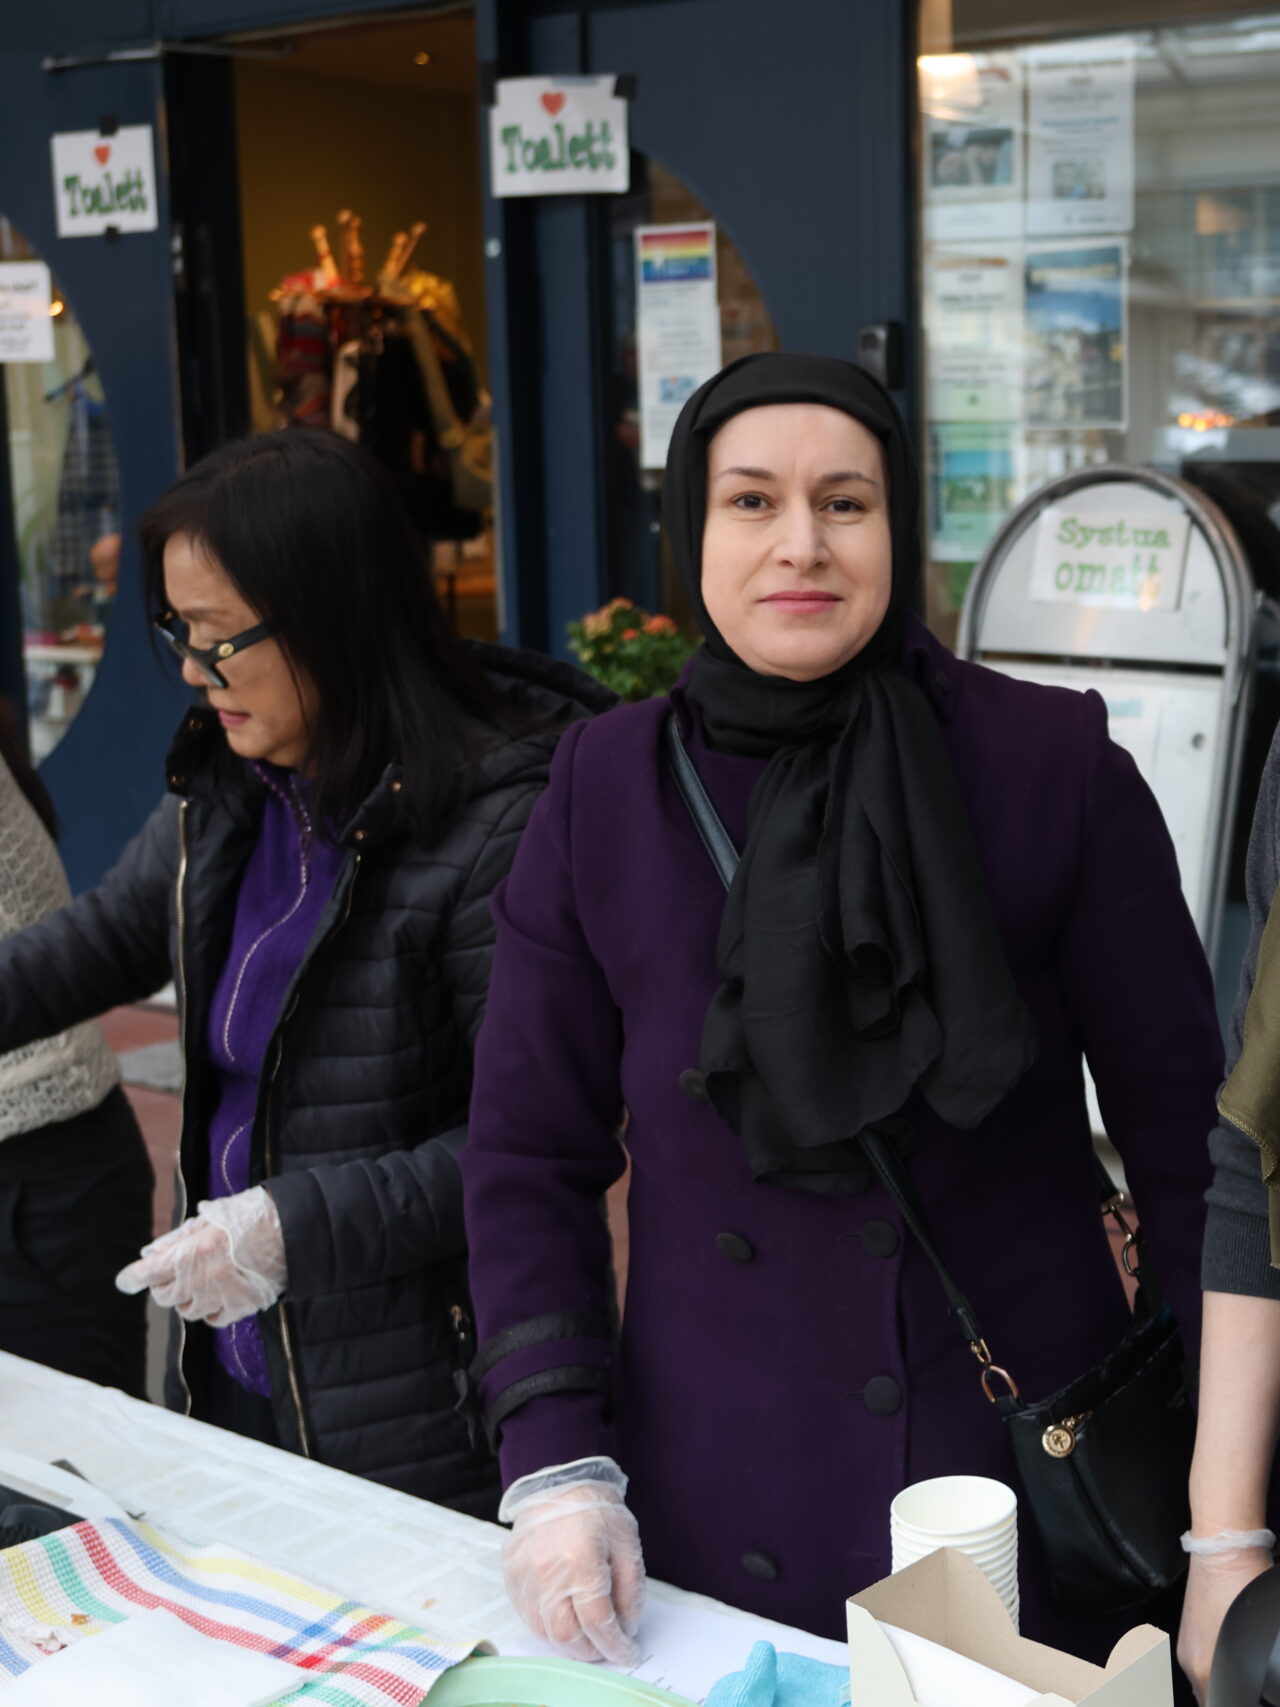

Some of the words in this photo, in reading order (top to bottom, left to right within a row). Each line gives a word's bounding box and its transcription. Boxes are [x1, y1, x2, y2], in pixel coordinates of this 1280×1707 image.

[501, 120, 616, 173] Toalett
[64, 168, 147, 217] Toalett
[1056, 517, 1172, 549] Systua
[1055, 552, 1160, 598] omatt
